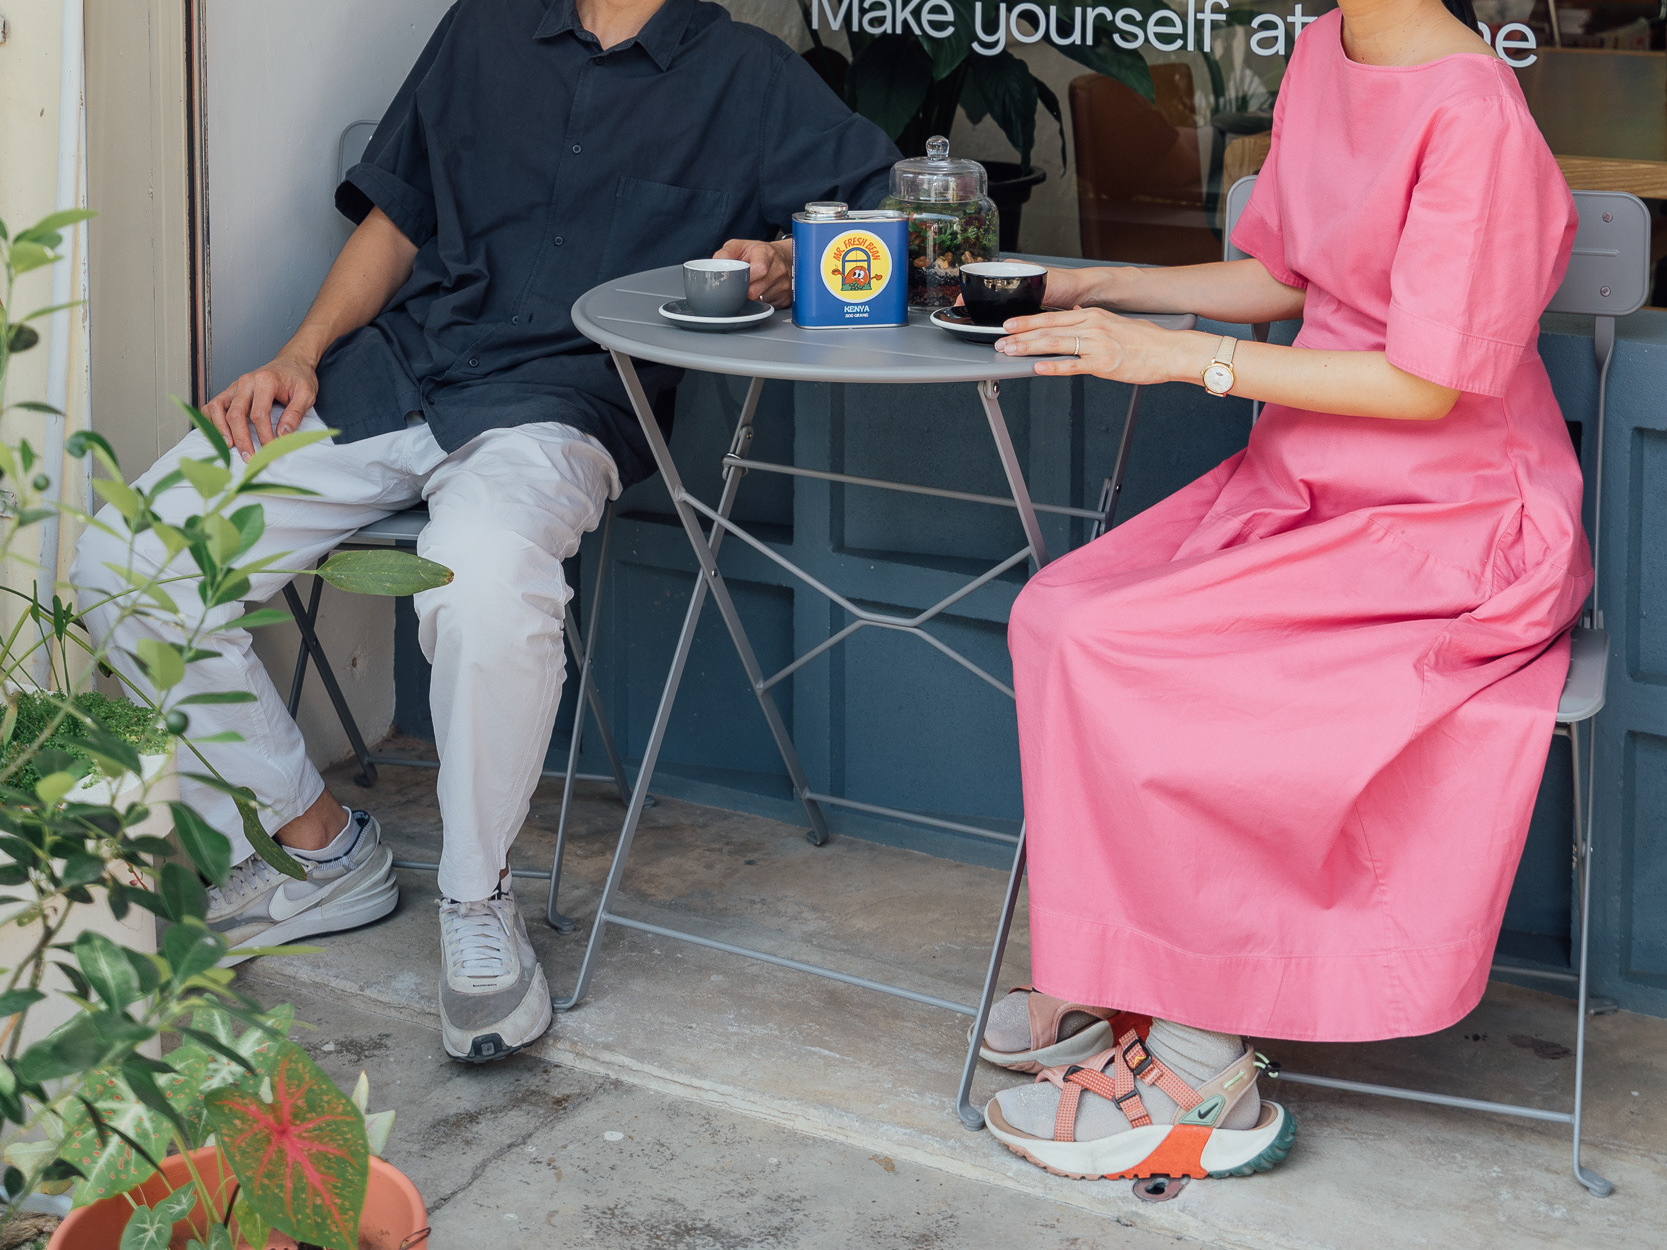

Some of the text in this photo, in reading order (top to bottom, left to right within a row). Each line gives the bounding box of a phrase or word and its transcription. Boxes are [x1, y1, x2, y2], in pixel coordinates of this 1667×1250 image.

[1250, 3, 1318, 55] at
[843, 237, 868, 249] FRESH
[865, 242, 881, 260] BEAN
